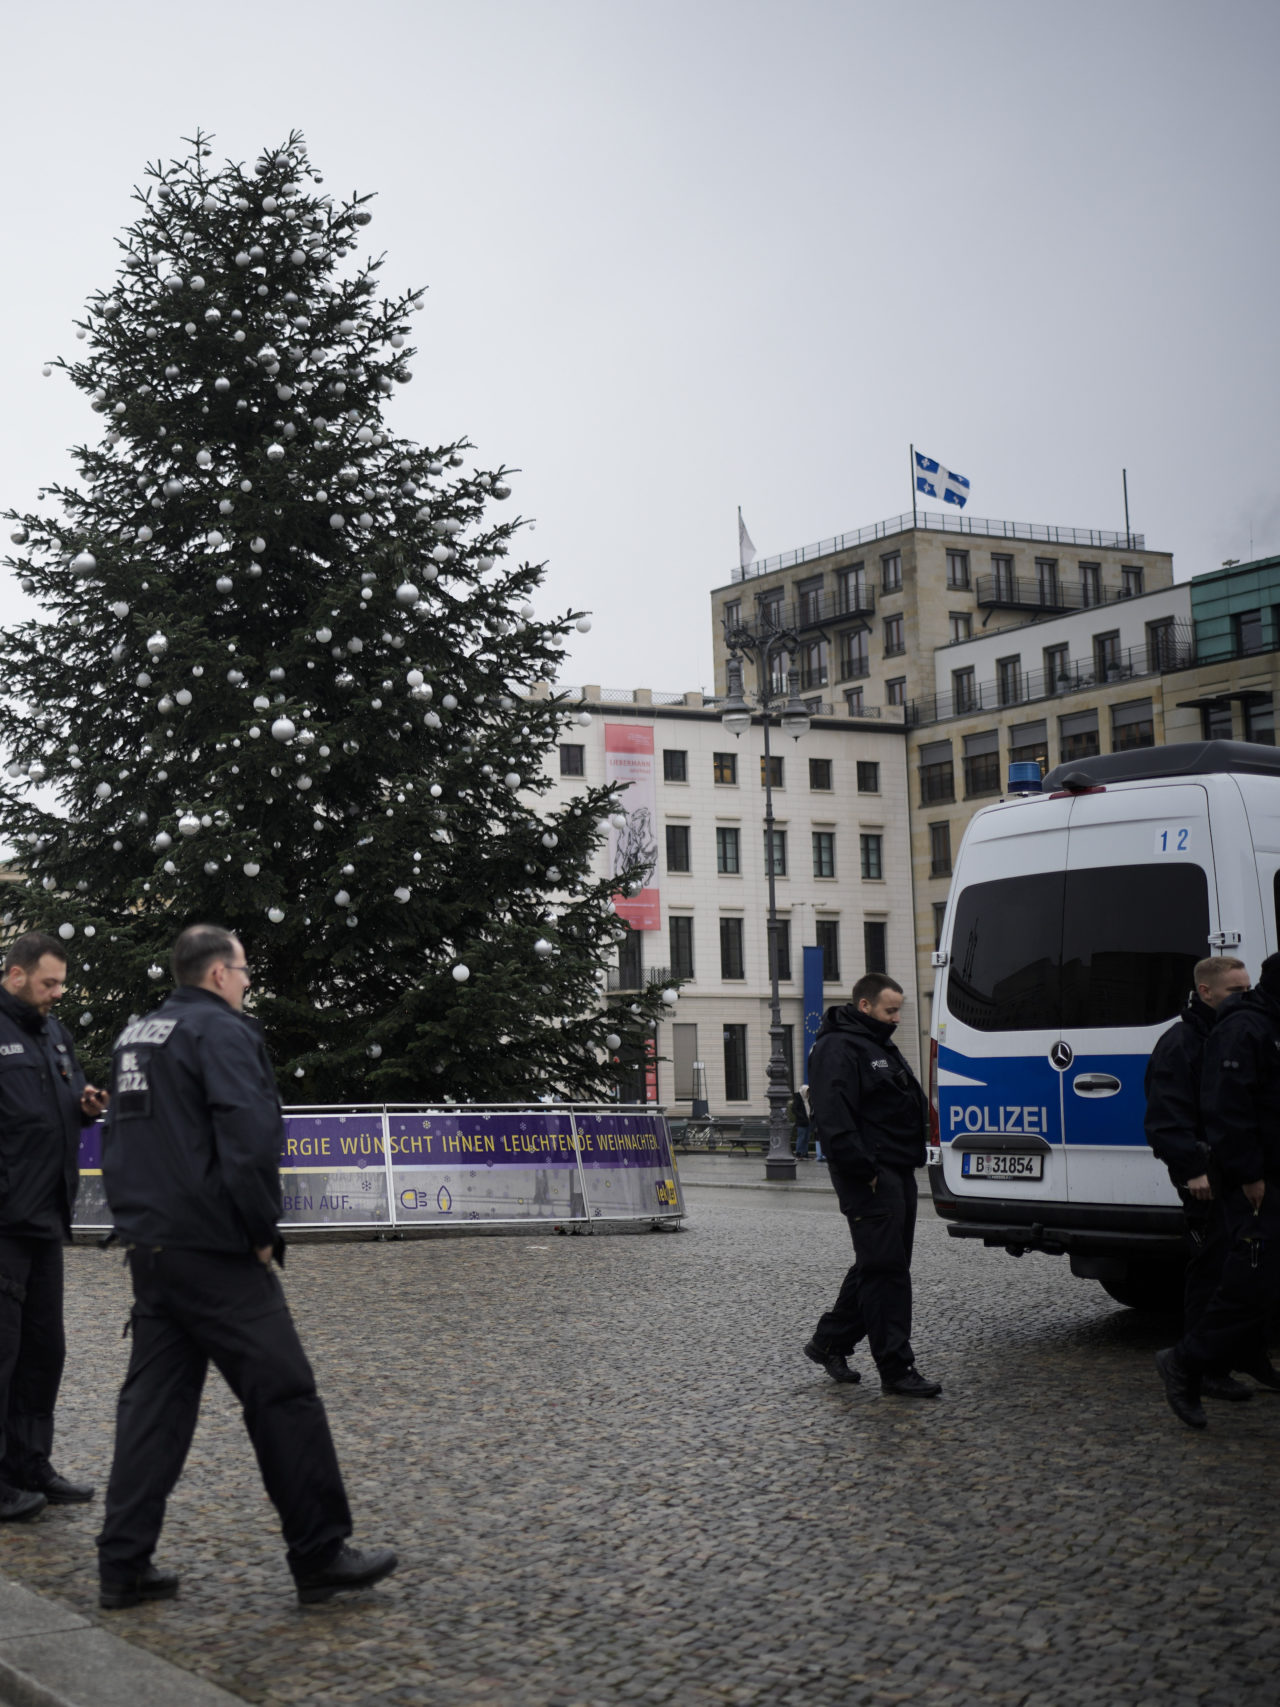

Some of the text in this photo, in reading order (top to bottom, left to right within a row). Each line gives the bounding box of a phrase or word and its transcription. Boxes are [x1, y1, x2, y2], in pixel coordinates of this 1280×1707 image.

[949, 1105, 1048, 1133] POLIZEI
[280, 1137, 331, 1156] RGIE
[339, 1133, 434, 1155] WÜNSCHT
[442, 1135, 496, 1153] IHNEN
[503, 1134, 593, 1152] LEUCHTENDE
[992, 1157, 1034, 1174] 31854
[319, 1195, 353, 1210] AUF.
